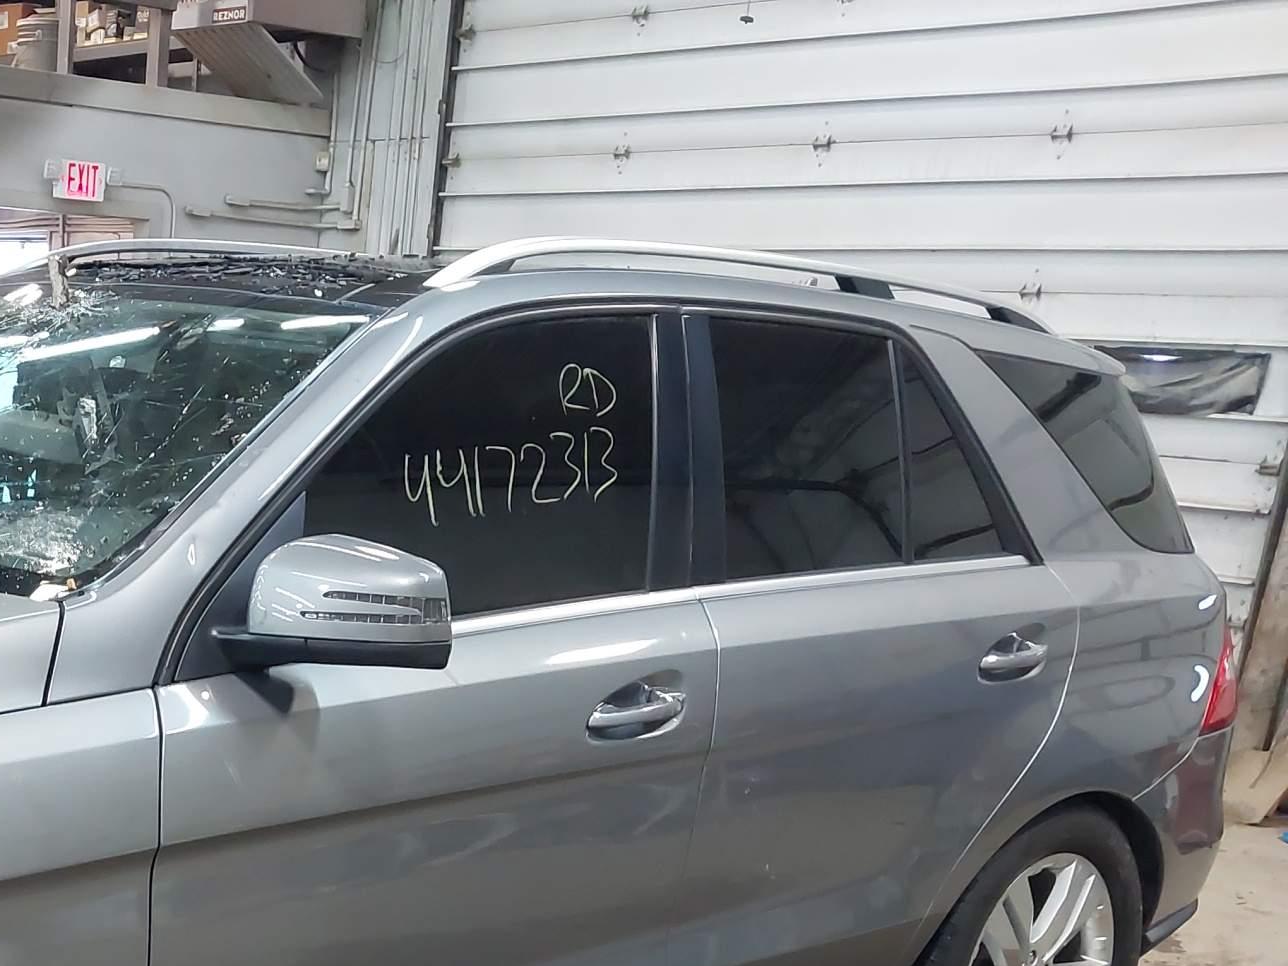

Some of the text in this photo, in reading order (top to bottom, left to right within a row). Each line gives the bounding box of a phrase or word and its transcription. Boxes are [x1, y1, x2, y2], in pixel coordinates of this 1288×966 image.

[213, 9, 245, 20] REZNOR
[67, 163, 99, 197] EXIT
[559, 363, 617, 416] RD
[404, 426, 618, 527] 44172313
